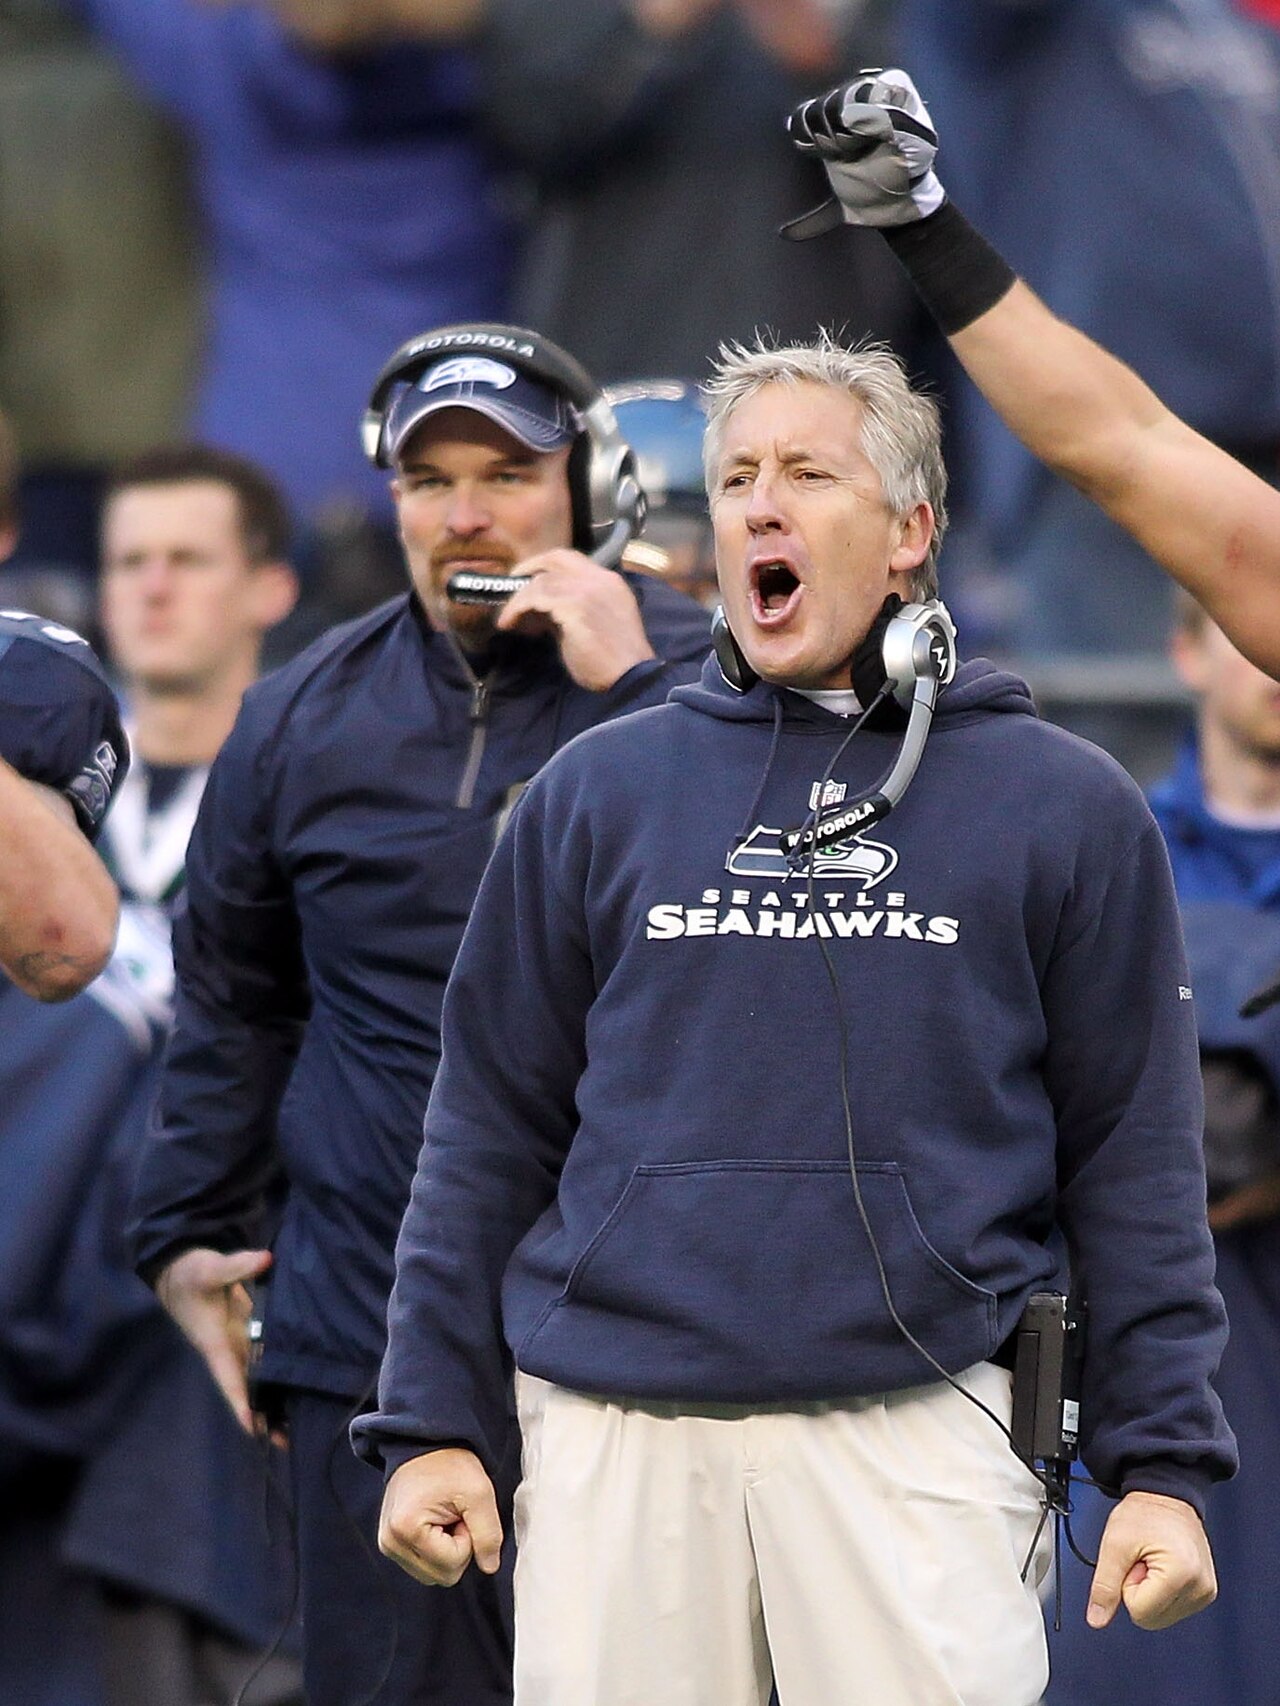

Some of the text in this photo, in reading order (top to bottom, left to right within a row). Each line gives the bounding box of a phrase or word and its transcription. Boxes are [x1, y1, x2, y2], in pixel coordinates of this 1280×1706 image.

[409, 332, 535, 358] MOTOROLA
[702, 888, 906, 908] SEATTLE
[647, 904, 960, 944] SEAHAWKS
